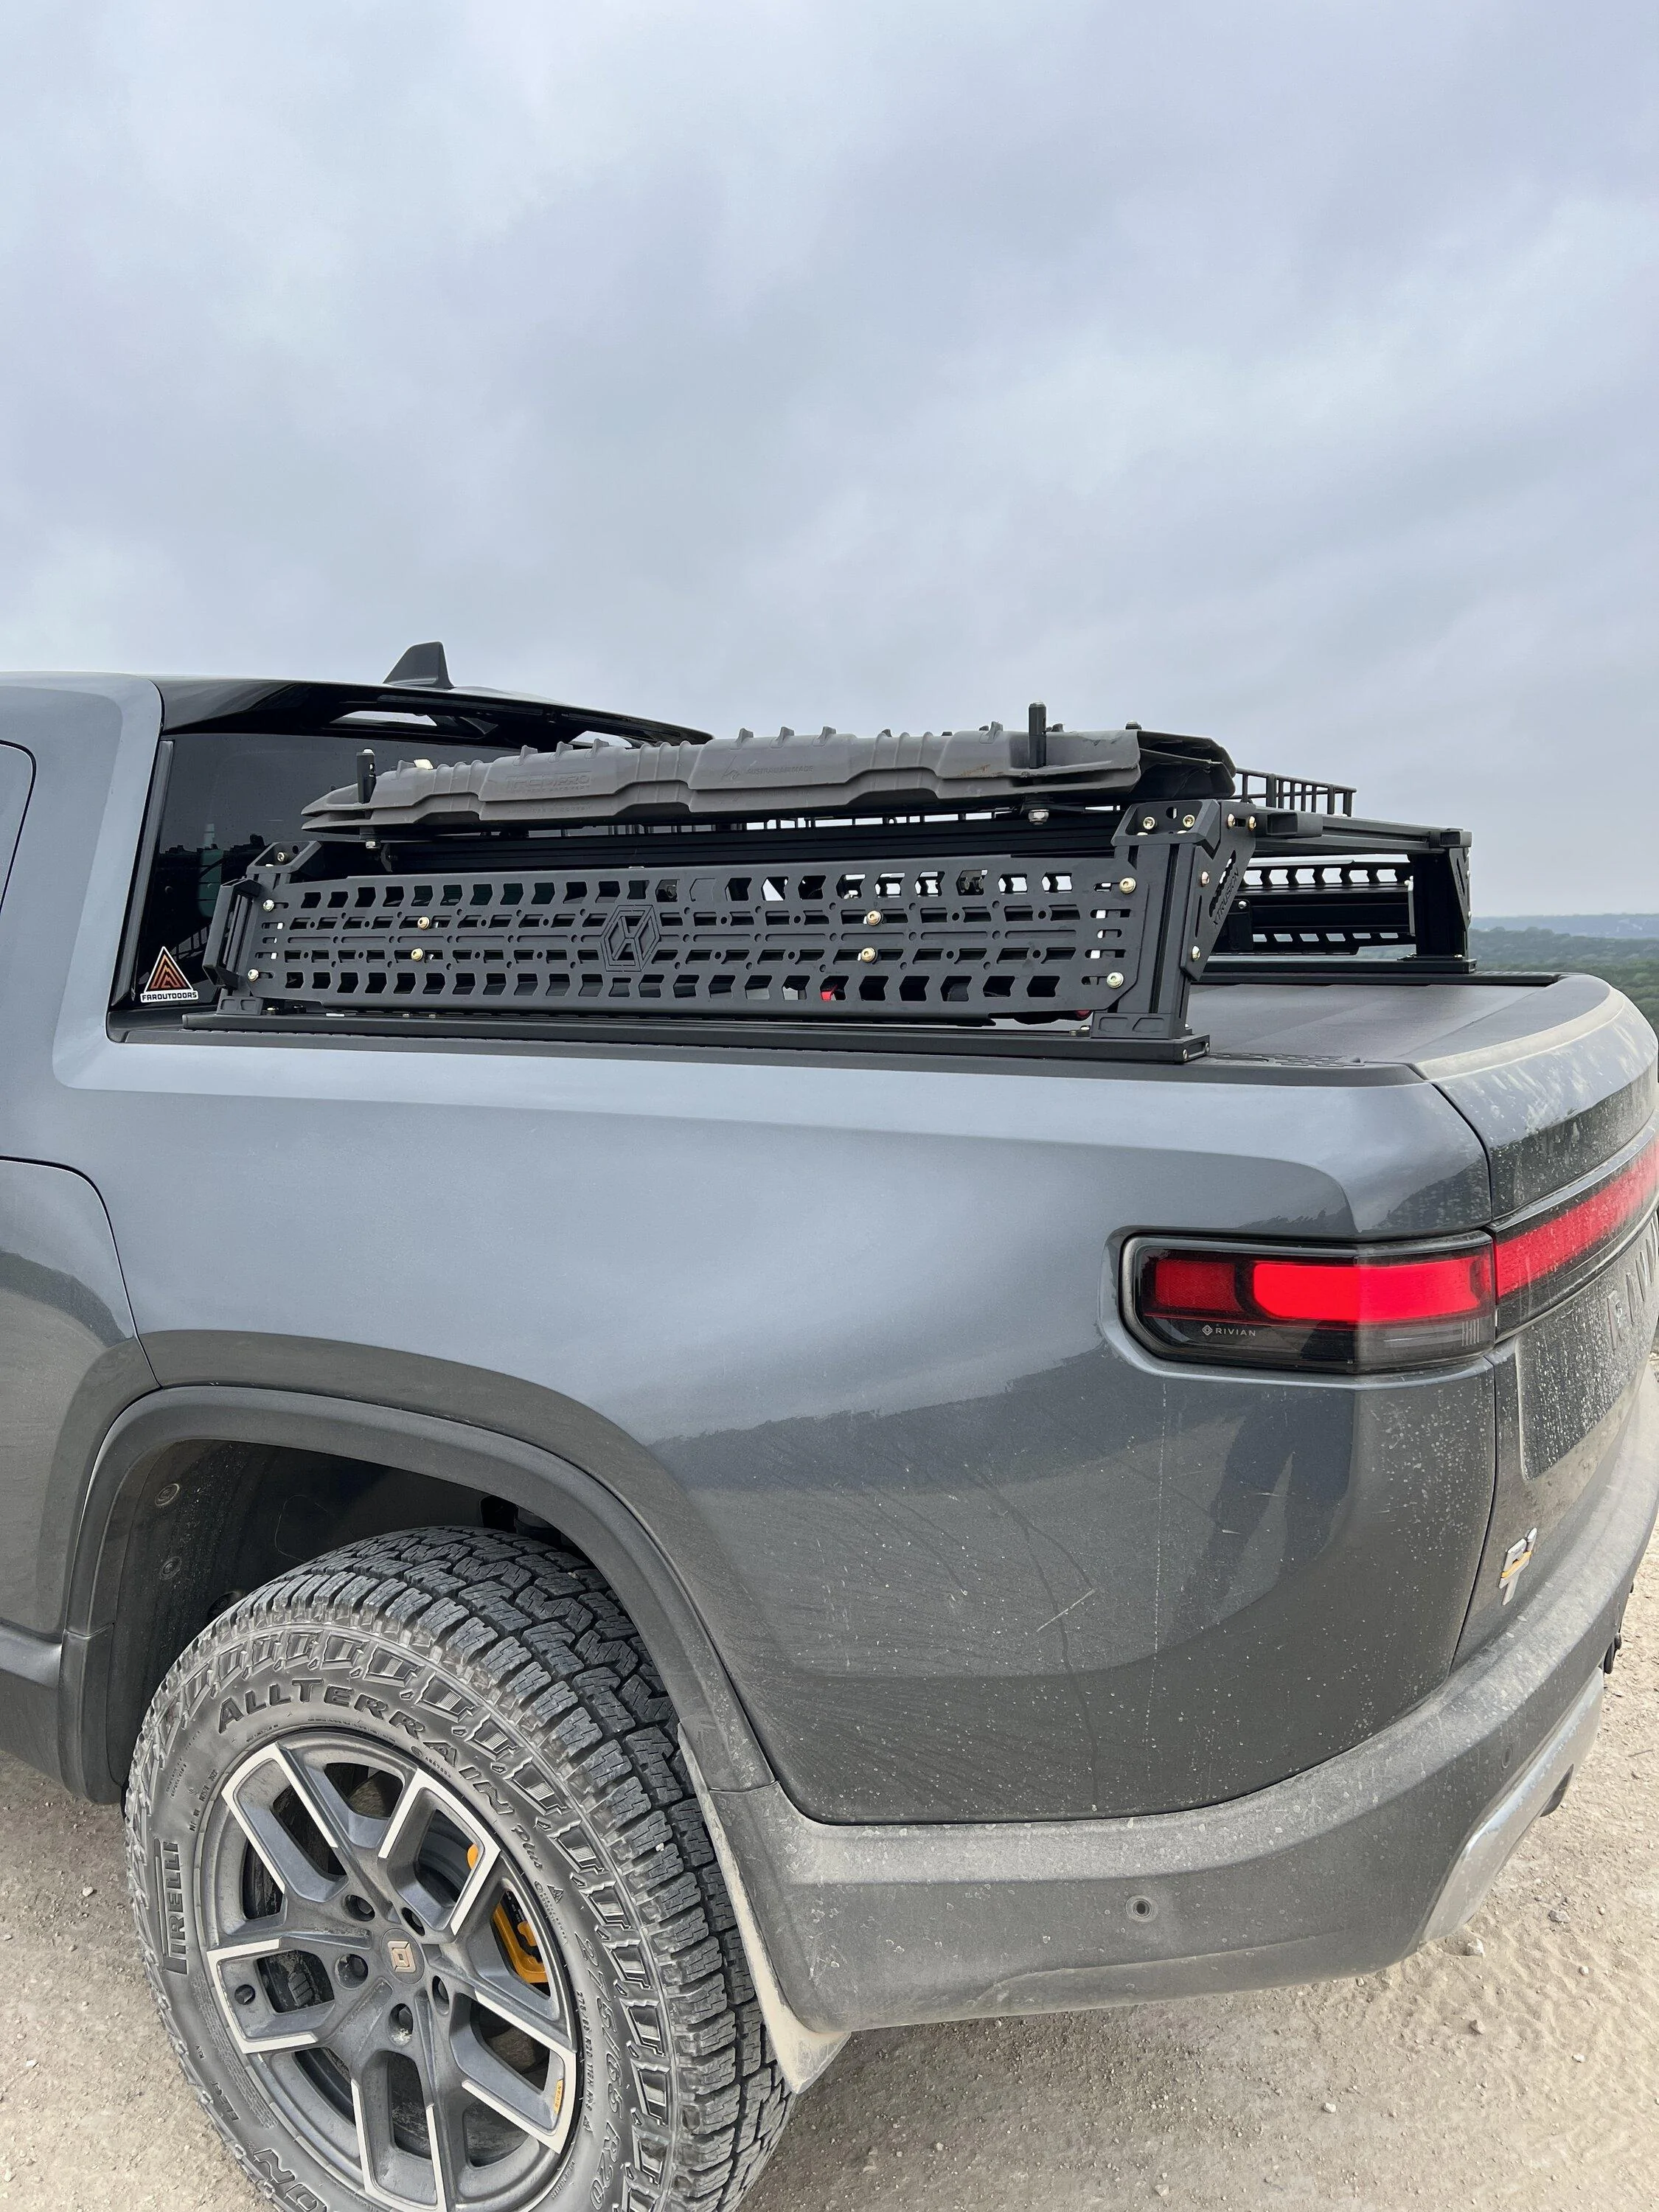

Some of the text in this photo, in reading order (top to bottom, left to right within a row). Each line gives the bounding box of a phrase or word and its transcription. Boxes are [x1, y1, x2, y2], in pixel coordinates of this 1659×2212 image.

[142, 992, 198, 1001] FAROUTDOORS
[1215, 1327, 1256, 1336] RIVIAN
[153, 1837, 188, 1975] PIRELLI
